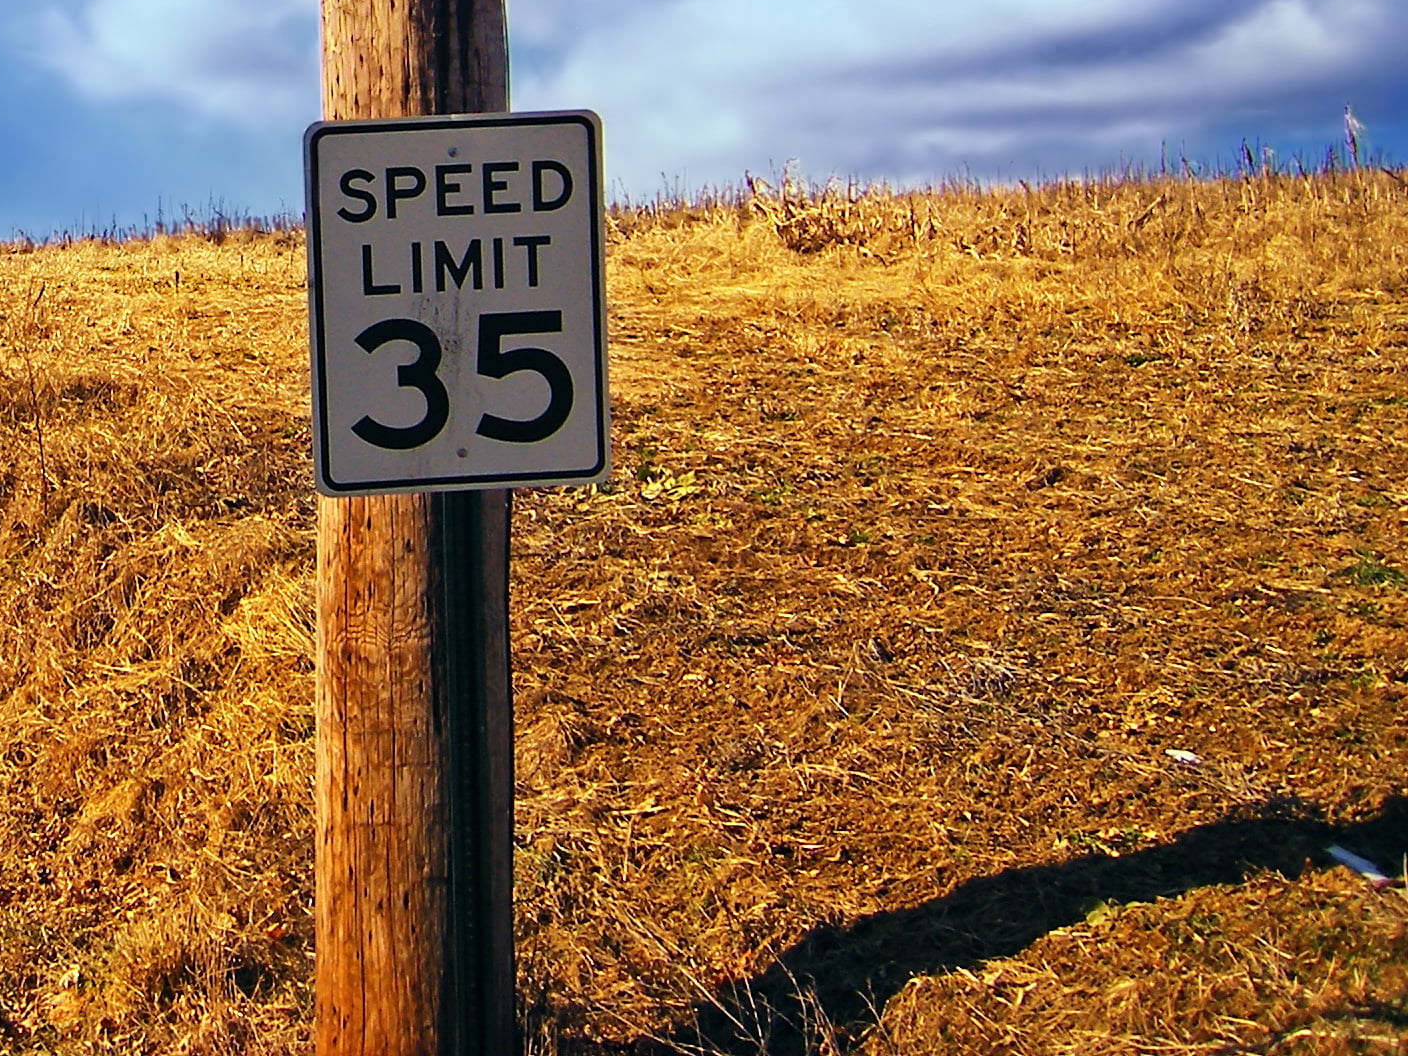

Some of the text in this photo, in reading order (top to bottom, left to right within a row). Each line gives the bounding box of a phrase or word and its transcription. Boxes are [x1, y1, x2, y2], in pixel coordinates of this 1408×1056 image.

[336, 160, 574, 223] SPEED
[361, 235, 552, 296] LIMIT
[350, 309, 574, 450] 35
